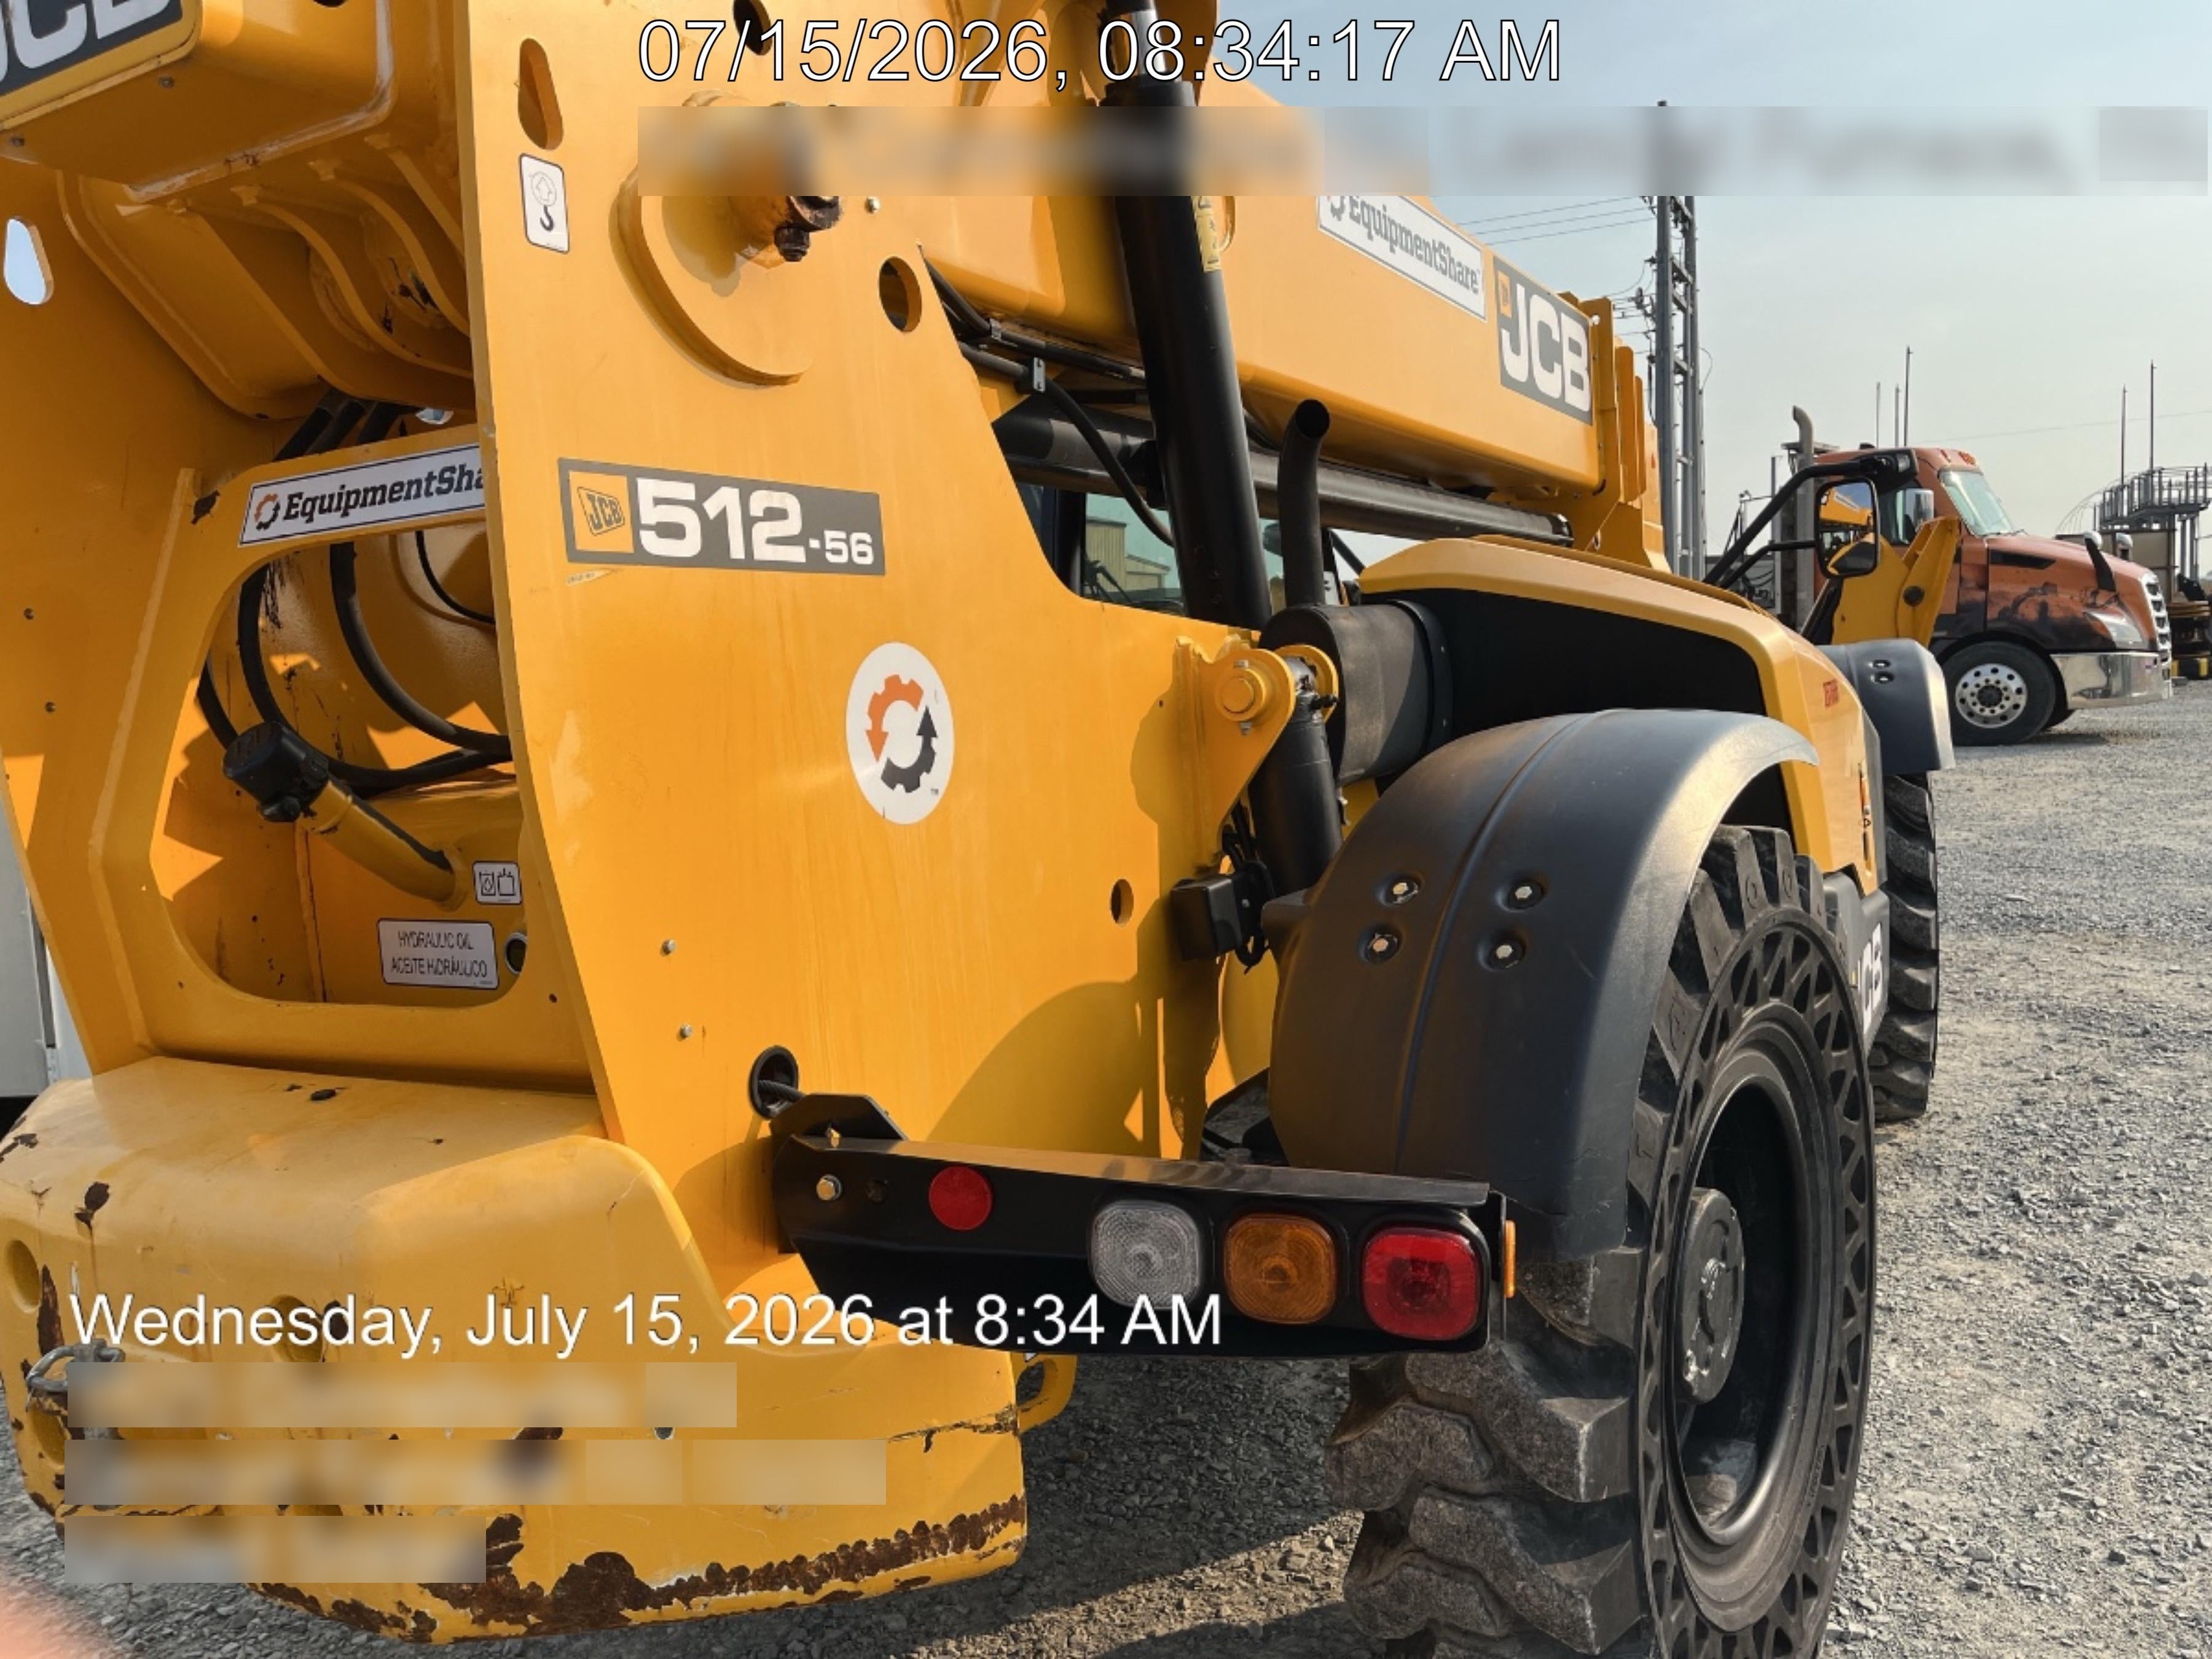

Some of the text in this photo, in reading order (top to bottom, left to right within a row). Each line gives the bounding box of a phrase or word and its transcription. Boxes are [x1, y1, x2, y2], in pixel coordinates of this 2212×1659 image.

[1501, 283, 1592, 412] JCB
[283, 462, 484, 524] EquipmentSha
[586, 493, 622, 530] JCB
[398, 930, 474, 950] HYDRAULIC OIL
[391, 957, 425, 975] ACEITE
[1857, 923, 1883, 1035] CB
